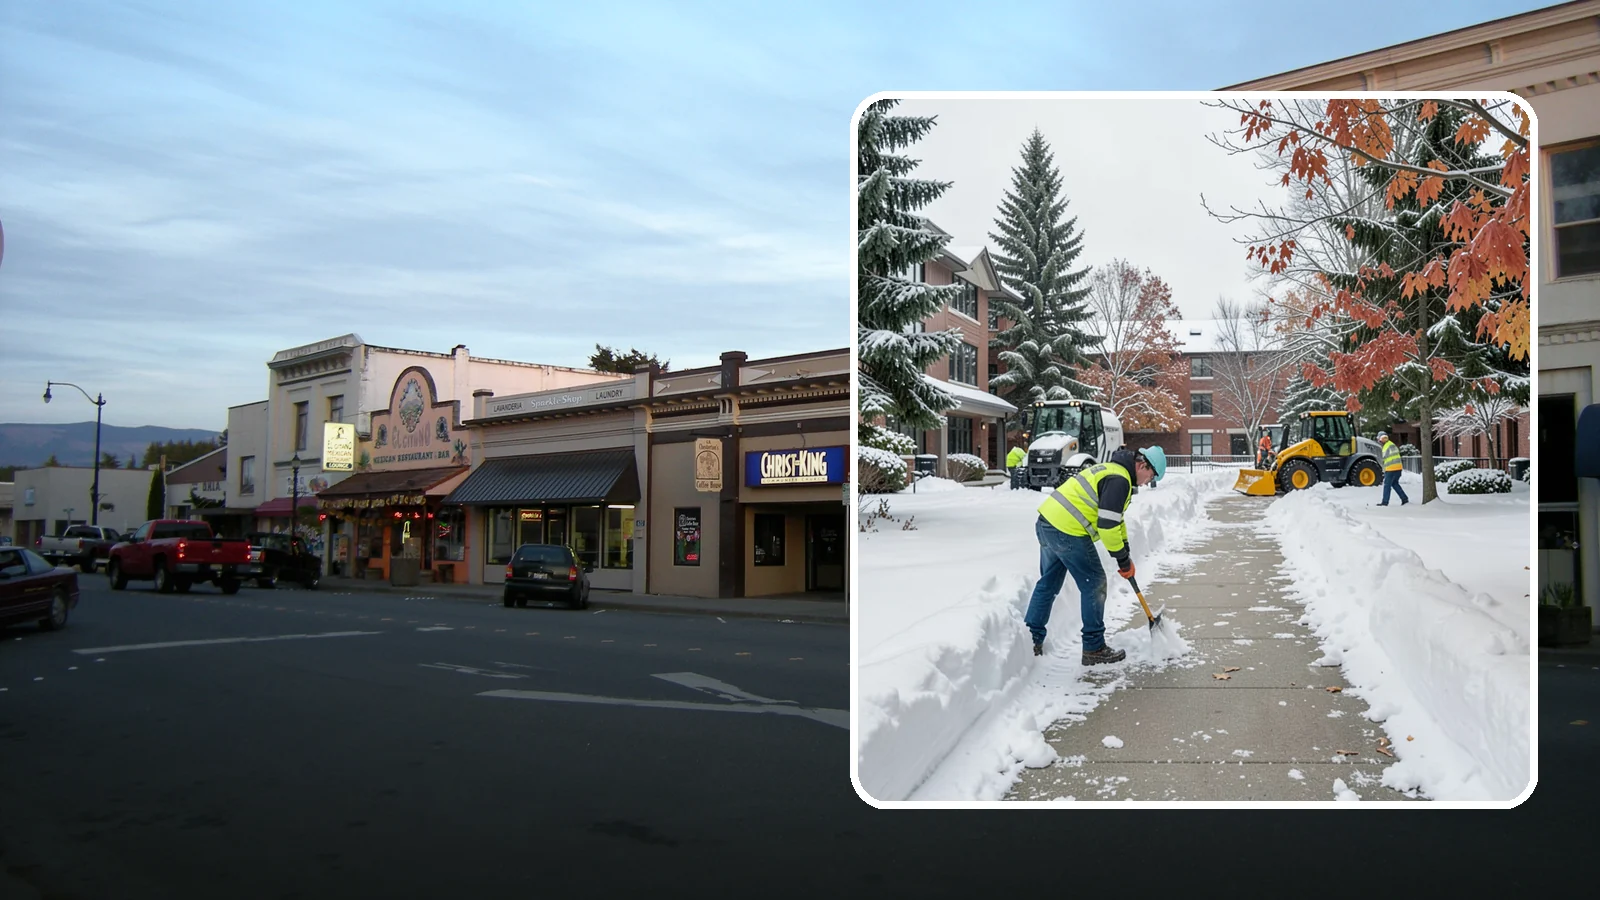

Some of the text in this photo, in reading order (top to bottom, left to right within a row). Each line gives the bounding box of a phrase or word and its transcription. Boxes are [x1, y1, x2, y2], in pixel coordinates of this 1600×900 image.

[562, 393, 582, 405] Shop
[595, 388, 623, 400] LAUNDRY
[493, 402, 522, 413] LAVANDERIA
[374, 454, 396, 464] MEXICAN
[398, 451, 433, 462] RESTAURANT
[438, 450, 450, 459] BAR
[761, 450, 827, 478] CHRIST KING
[696, 480, 722, 489] Coffee House
